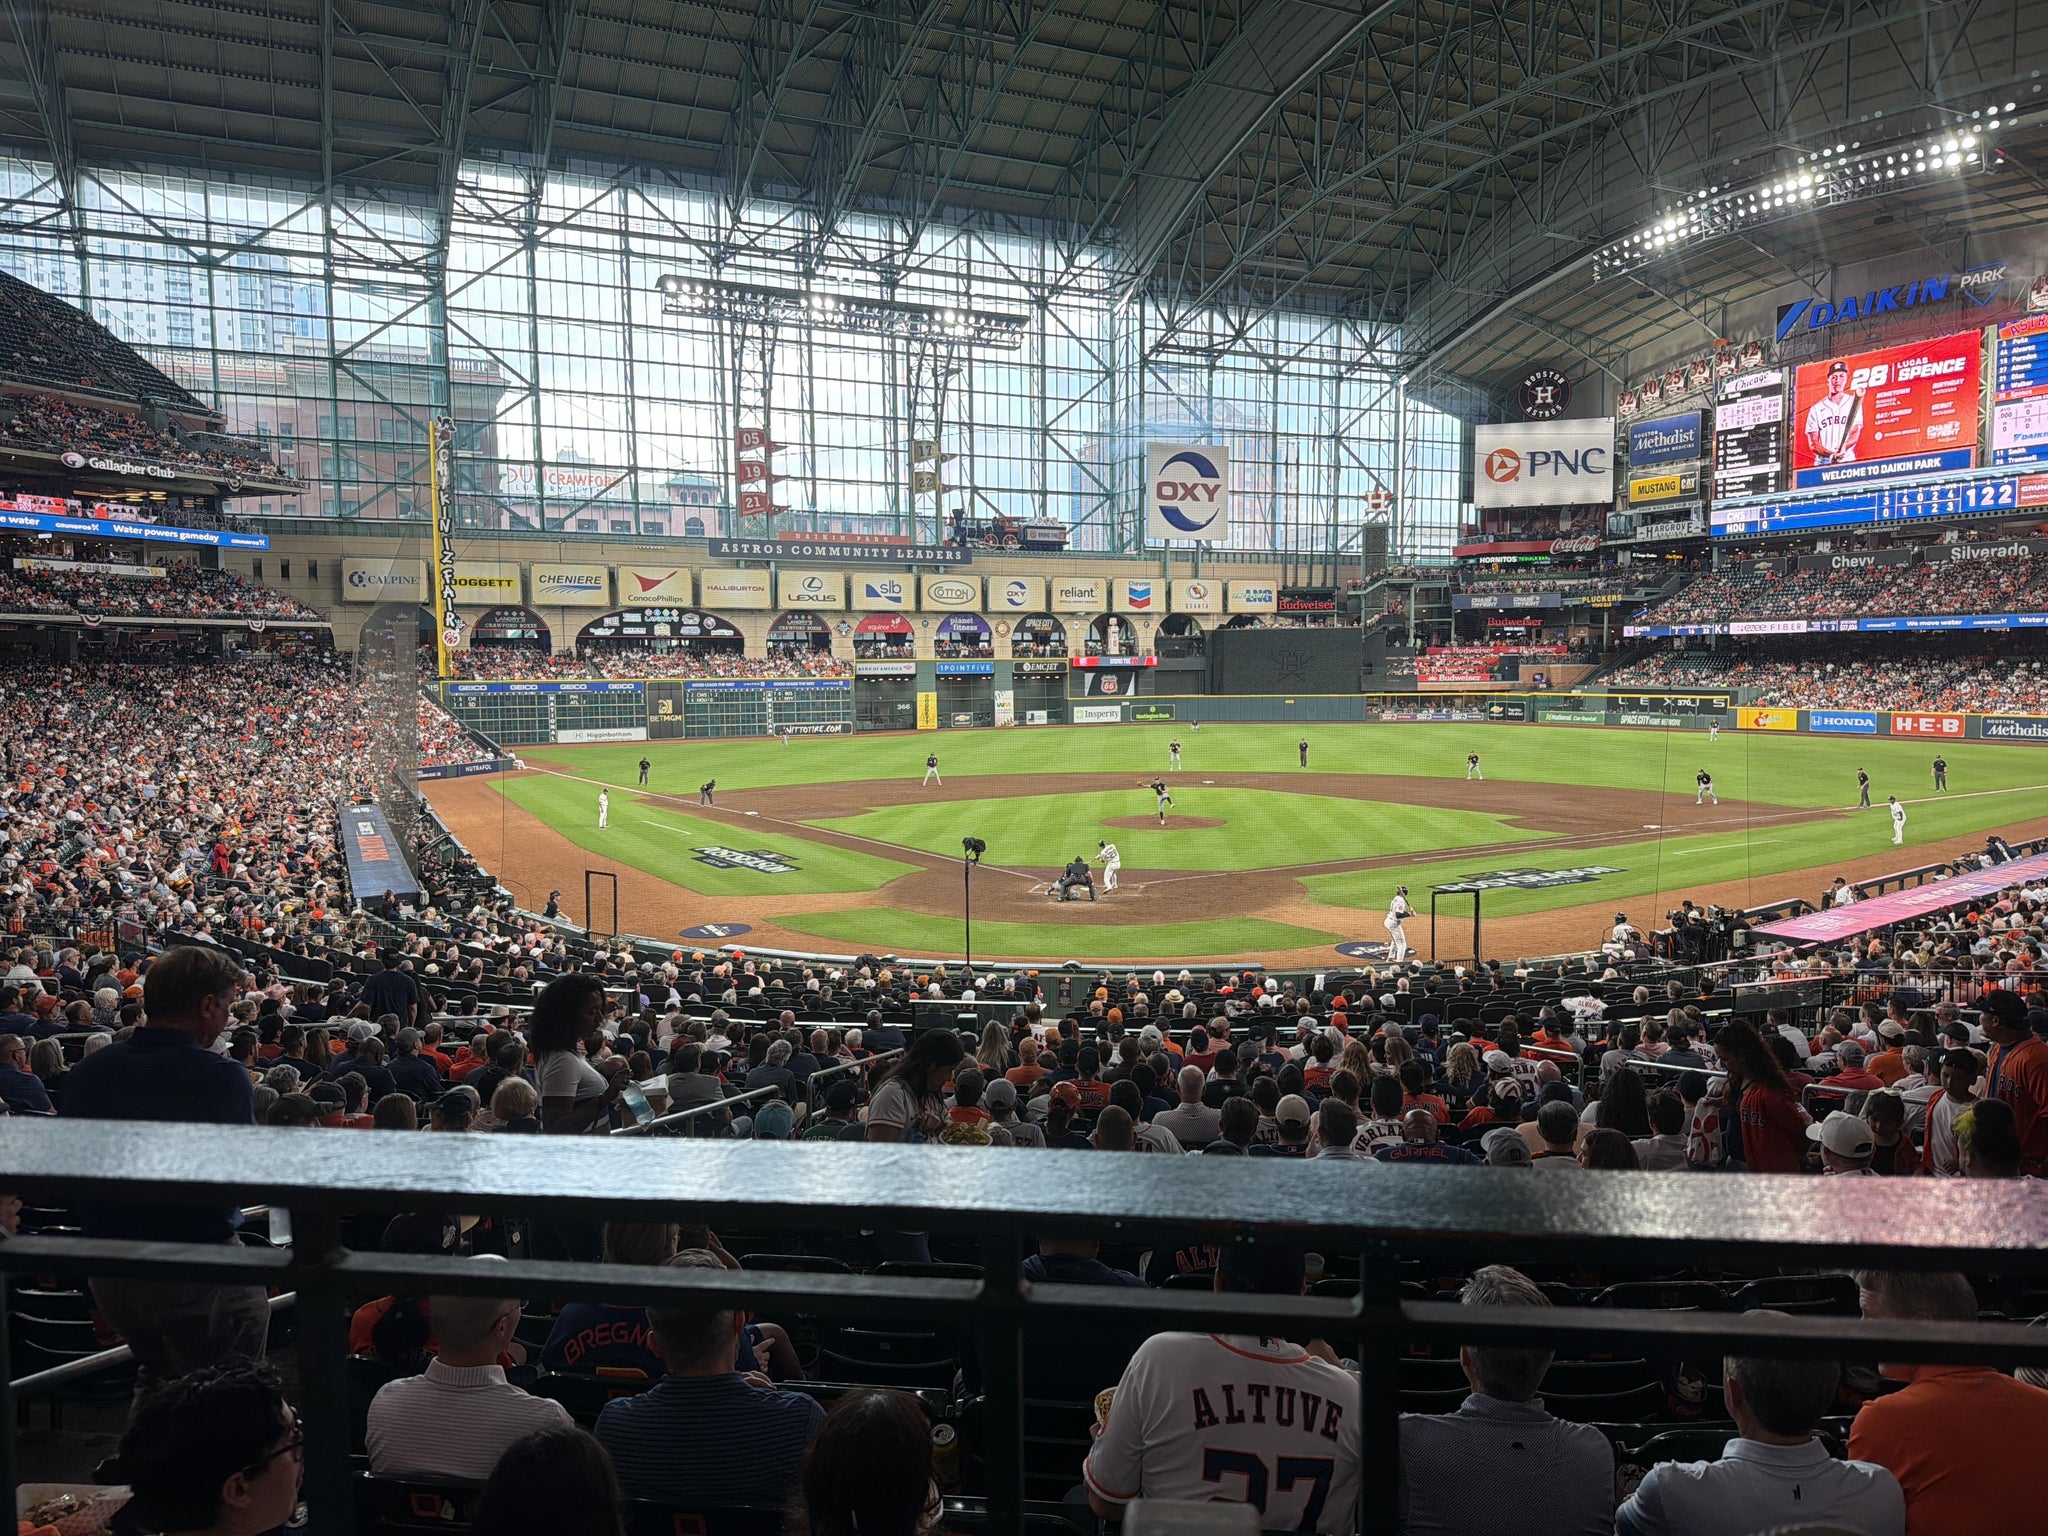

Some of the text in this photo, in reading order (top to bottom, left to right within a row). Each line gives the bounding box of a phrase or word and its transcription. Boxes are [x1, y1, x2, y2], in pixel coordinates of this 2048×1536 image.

[1808, 266, 2007, 329] DAIKIN PARK
[1741, 341, 1759, 357] 42
[1715, 351, 1732, 367] 34
[1897, 357, 1928, 368] LUCAS
[1690, 360, 1706, 375] 33
[1898, 357, 1966, 382] SPENCE
[1524, 371, 1565, 386] HOUSTON
[1665, 370, 1682, 386] 25
[1850, 364, 1889, 391] 28
[1641, 380, 1658, 396] 40
[1618, 390, 1634, 406] 32
[1526, 405, 1562, 417] ASTROS
[743, 433, 760, 445] 05
[1634, 428, 1695, 451] Methodist
[918, 446, 932, 457] 17
[88, 457, 175, 478] Gallagher Club
[1526, 448, 1606, 477] PNC
[746, 467, 761, 478] 19
[1822, 458, 1941, 481] WELCOME TO DAIKIN PARK
[918, 477, 932, 488] 22
[1638, 478, 1695, 495] MUSTANG CAT
[1156, 481, 1222, 502] OXY
[1966, 488, 1976, 507] 1
[1981, 486, 1994, 506] 2
[1998, 484, 2012, 505] 2
[746, 496, 761, 508] 21
[1726, 511, 1746, 521] CWS
[9, 514, 40, 526] water
[113, 524, 143, 535] Water
[144, 528, 178, 538] powers
[179, 532, 219, 543] gameday
[1646, 522, 1693, 538] HARGROVE
[1726, 523, 1745, 533] HOU
[1762, 521, 1768, 530] 0
[796, 533, 845, 541] DAIKIN
[721, 543, 961, 560] ASTROS COMMUNITY LEADERS
[1951, 542, 2029, 561] Silverado
[1832, 555, 1875, 569] Chevy
[368, 575, 419, 585] CALPINE
[450, 578, 513, 587] DOGGETT
[539, 574, 602, 585] CHENIERE
[707, 584, 765, 592] HALLIBURTON
[879, 579, 902, 594] slb
[1060, 586, 1096, 598] reliant
[441, 569, 456, 628] FAIR
[628, 594, 684, 603] ConocoPhillips
[788, 594, 836, 602] LEXUS
[934, 586, 969, 600] COTTON
[1582, 594, 1623, 604] PLUCKERS
[1279, 600, 1336, 610] Budweiser
[950, 617, 974, 626] planet
[1025, 618, 1054, 628] SPACE CITY
[1487, 617, 1544, 626] Budweiser
[2018, 616, 2043, 624] Water
[1715, 624, 1722, 634] K
[1770, 623, 1802, 632] FIBER
[1103, 681, 1115, 690] 66
[1084, 709, 1119, 719] Insperity
[1551, 714, 1571, 722] National
[1621, 714, 1637, 725] SPACE
[1637, 715, 1650, 725] CITY
[1661, 718, 1681, 726] NETWORK
[1824, 717, 1875, 727] HONDA
[587, 731, 632, 739] Higginbotham
[465, 764, 492, 772] NUTRAFOL
[694, 847, 797, 873] POSTSEASON
[1436, 865, 1620, 891] POSTSEASON
[1192, 1383, 1344, 1443] ALTUVE
[1203, 1447, 1335, 1533] 27
